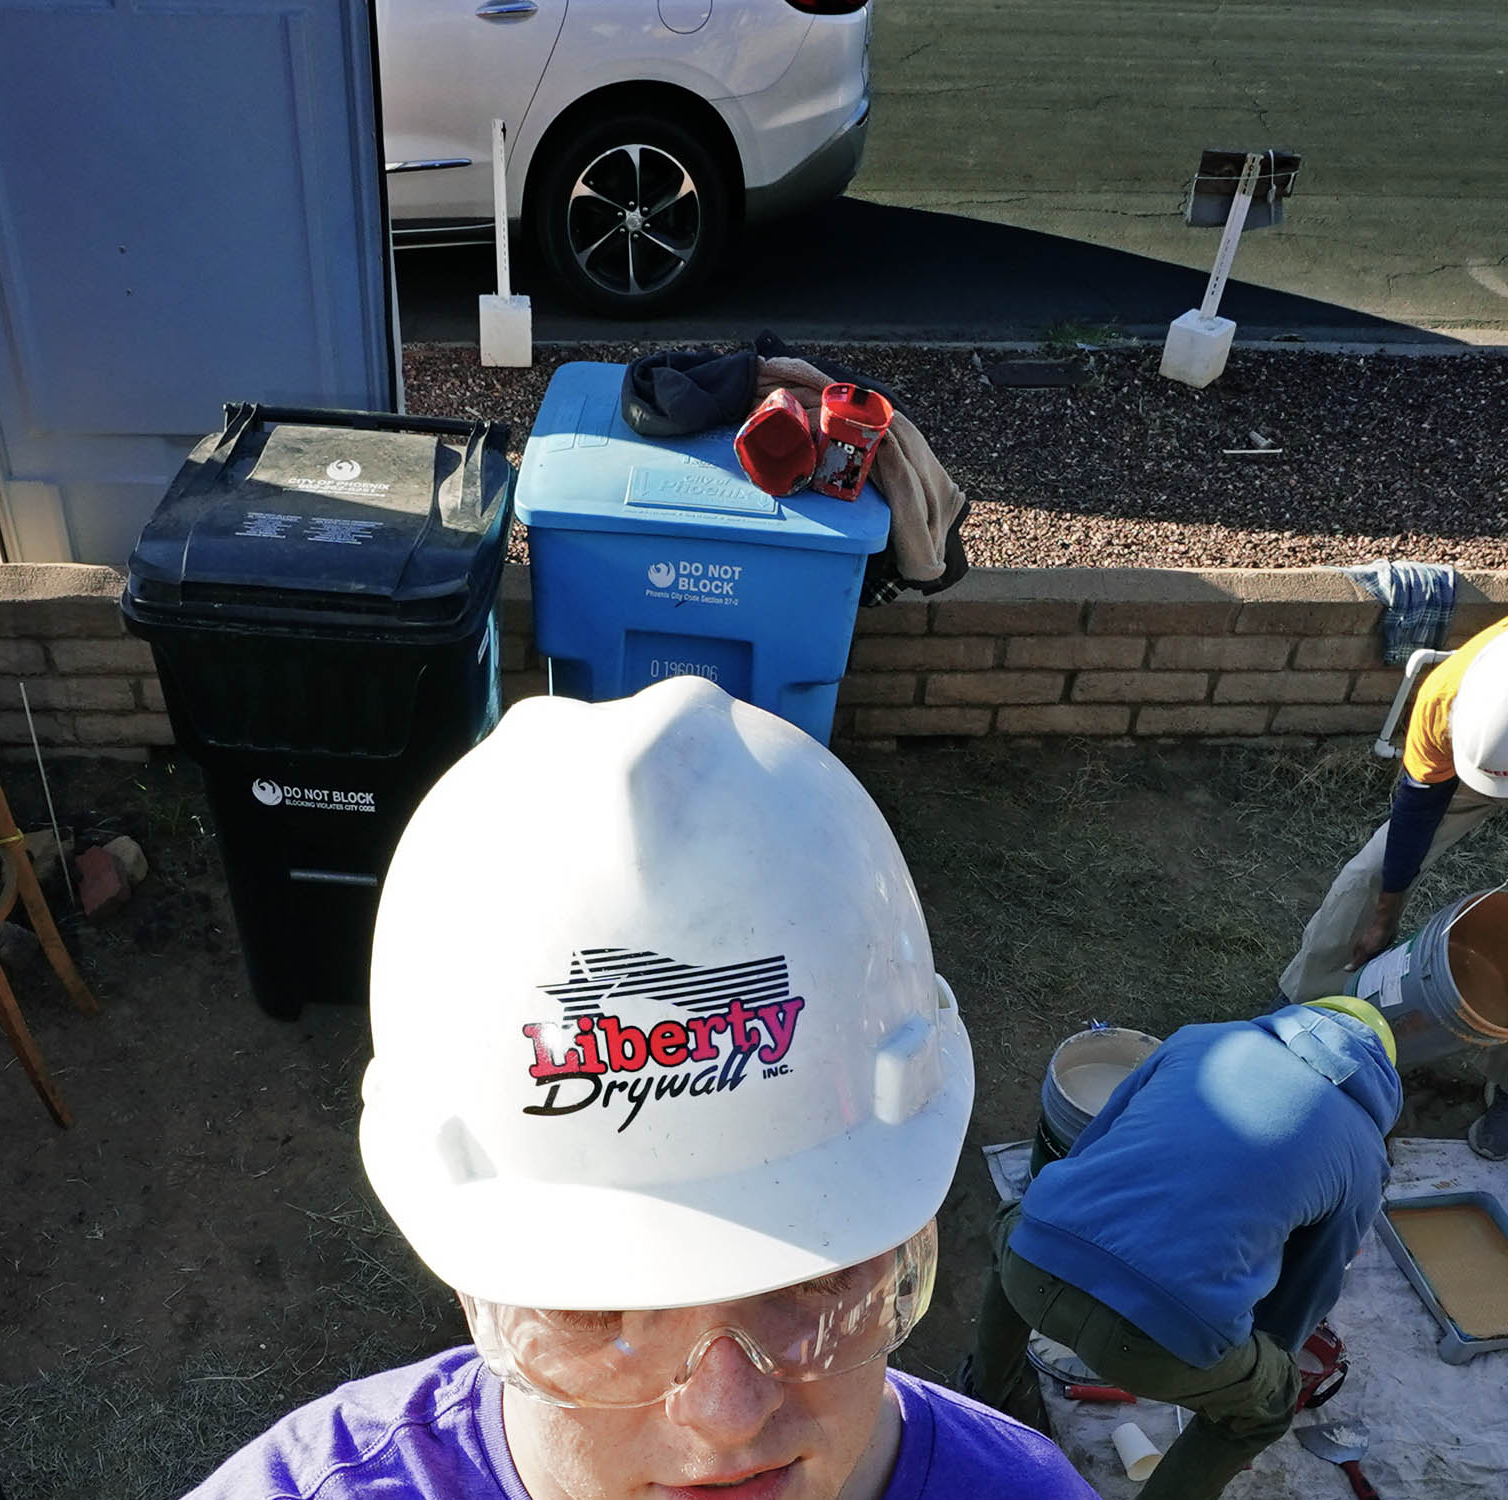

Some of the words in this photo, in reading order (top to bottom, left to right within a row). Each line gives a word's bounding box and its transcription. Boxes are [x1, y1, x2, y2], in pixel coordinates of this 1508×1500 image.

[337, 481, 390, 490] PHOENIX
[679, 561, 703, 576] DO
[708, 564, 743, 580] NOT
[671, 591, 683, 601] City
[678, 577, 734, 596] BLOCK
[283, 785, 302, 799] DO
[304, 788, 329, 801] NOT
[332, 791, 375, 805] BLOCK
[285, 798, 315, 808] BLOCKING
[344, 804, 358, 812] CITY
[358, 805, 376, 813] CODE
[522, 996, 805, 1080] Liberty
[522, 1046, 759, 1134] Drywall
[761, 1064, 795, 1081] INC.
